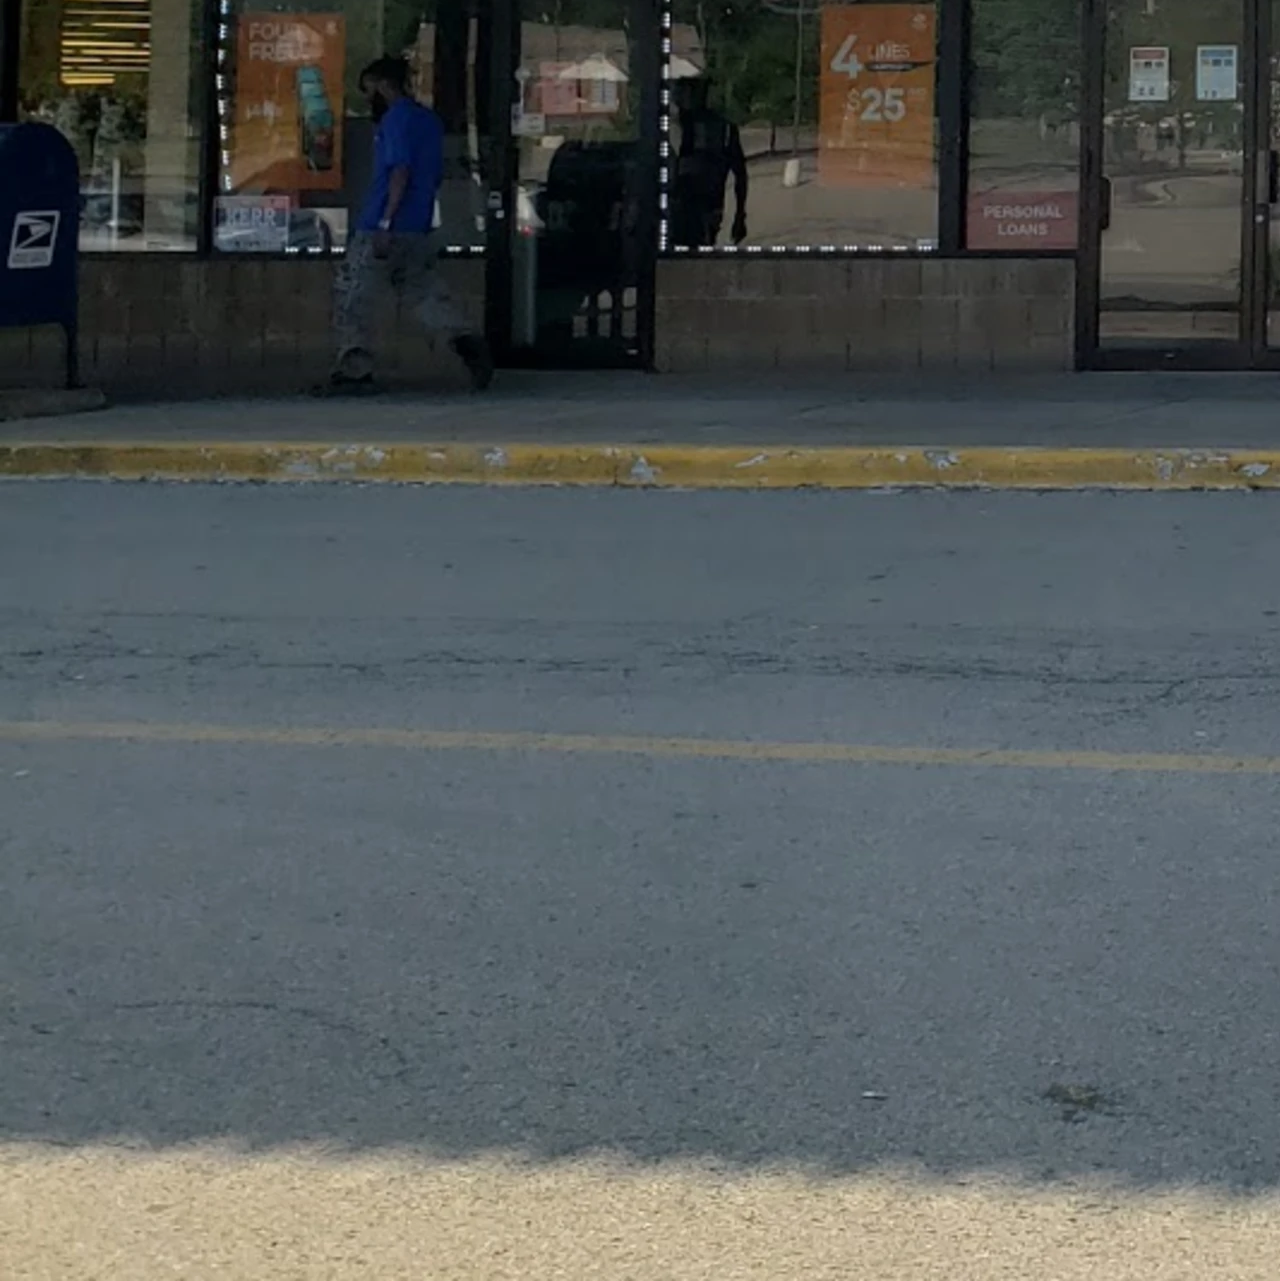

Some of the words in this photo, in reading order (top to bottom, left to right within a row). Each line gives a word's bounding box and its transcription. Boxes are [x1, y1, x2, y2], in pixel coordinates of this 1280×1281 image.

[830, 34, 863, 80] 4
[983, 205, 1064, 219] PERSONAL
[997, 223, 1049, 236] LOANS
